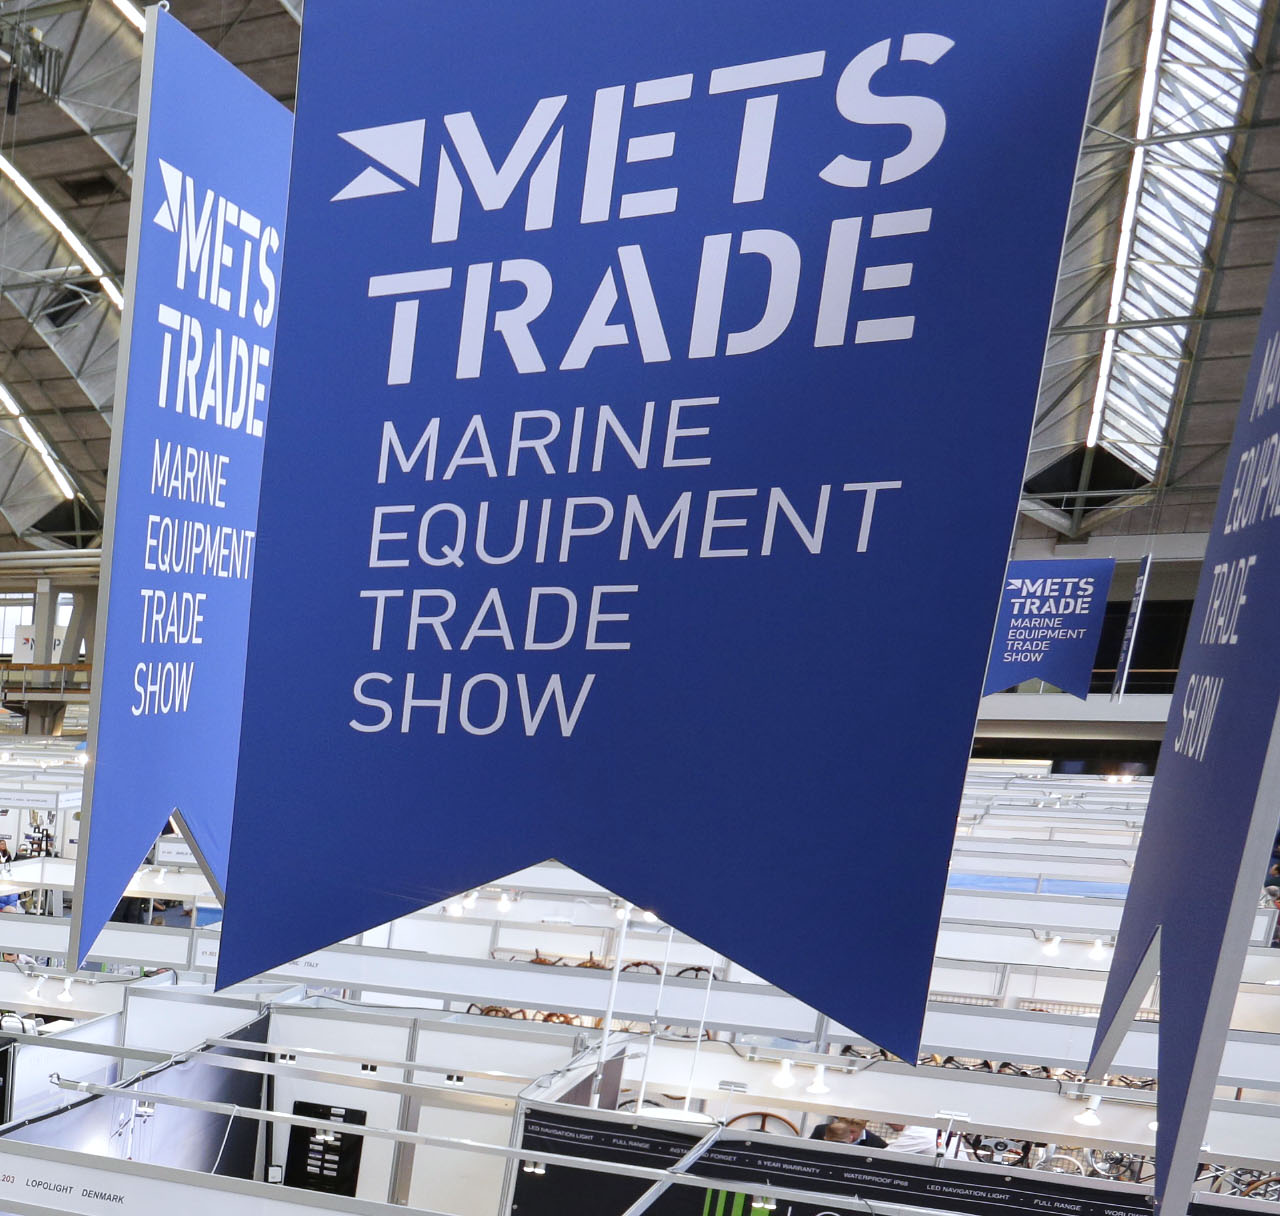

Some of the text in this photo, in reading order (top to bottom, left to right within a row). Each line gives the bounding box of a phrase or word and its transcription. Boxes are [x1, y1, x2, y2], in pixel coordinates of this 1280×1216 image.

[431, 33, 956, 243] METS
[177, 175, 280, 328] METS
[367, 207, 932, 385] TRADE
[158, 303, 270, 438] TRADE
[151, 438, 230, 508] MARINE
[377, 397, 720, 485] MARINE
[1224, 432, 1280, 535] EQUIPM
[144, 514, 256, 580] EQUIPMENT
[368, 480, 902, 569] EQUIPMENT
[140, 588, 207, 644] TRADE
[359, 584, 639, 653] TRADE
[1010, 597, 1092, 615] TRADE
[1020, 577, 1095, 597] METS
[1199, 554, 1257, 645] TRADE
[1006, 640, 1051, 651] TRADE
[1008, 628, 1087, 640] EQUIPMENT
[1010, 617, 1064, 628] MARINE
[131, 661, 195, 717] SHOW
[1003, 652, 1044, 662] SHOW
[349, 671, 597, 739] SHOW
[1174, 673, 1224, 762] SHOW
[576, 1133, 594, 1141] LIGHT
[25, 1178, 74, 1195] LOPOLIGHT
[81, 1187, 126, 1205] DENMARK
[710, 1152, 737, 1162] FORGET
[763, 1160, 781, 1169] YEAR
[782, 1163, 820, 1175] WARRANTY
[843, 1172, 892, 1185] WATERPROOF
[926, 1183, 941, 1193] LED
[942, 1185, 986, 1198] NAVIGATION
[986, 1191, 1010, 1201] LIGHT
[1034, 1198, 1052, 1207] FULL
[1053, 1201, 1082, 1212] RANGE
